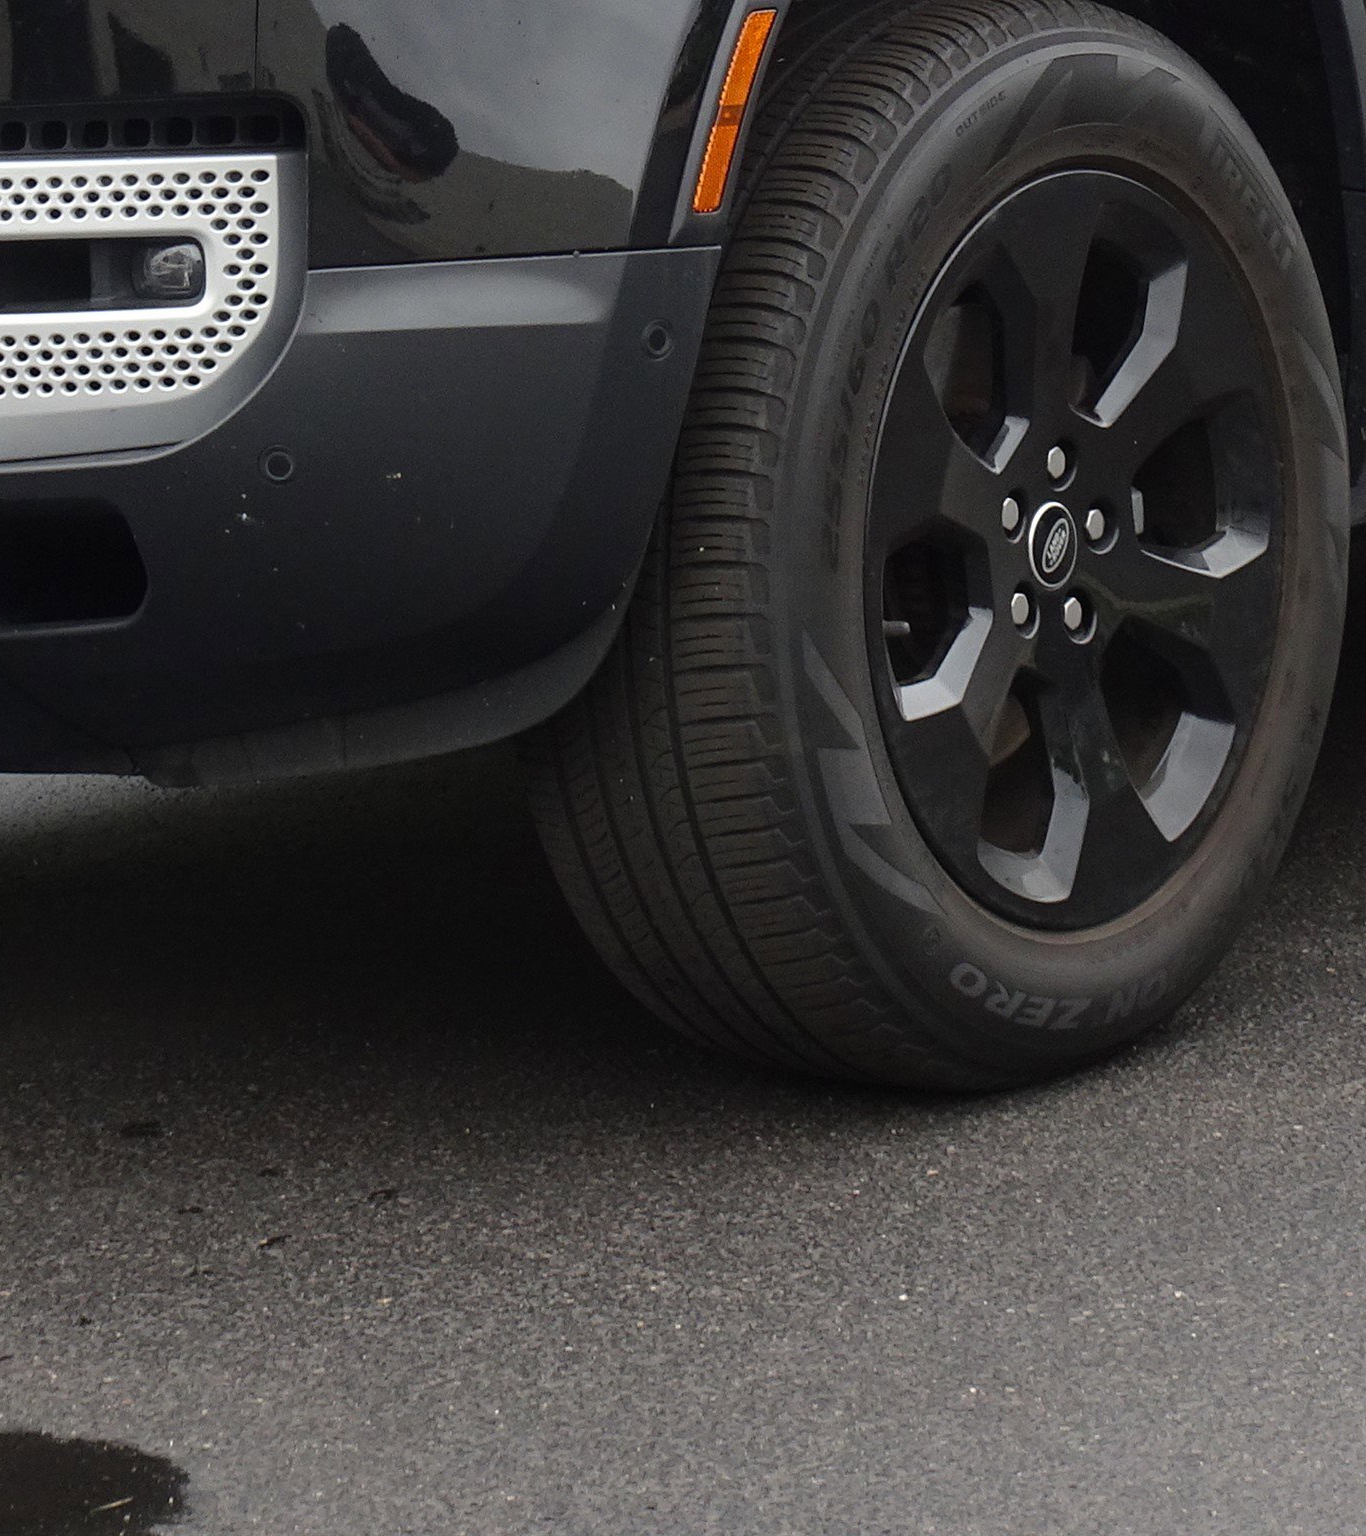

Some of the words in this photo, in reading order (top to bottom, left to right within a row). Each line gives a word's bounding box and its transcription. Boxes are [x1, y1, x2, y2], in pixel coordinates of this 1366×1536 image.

[955, 91, 1006, 138] OUTSIDE
[1198, 106, 1298, 271] PIRELLI
[949, 962, 1093, 1030] ZERO
